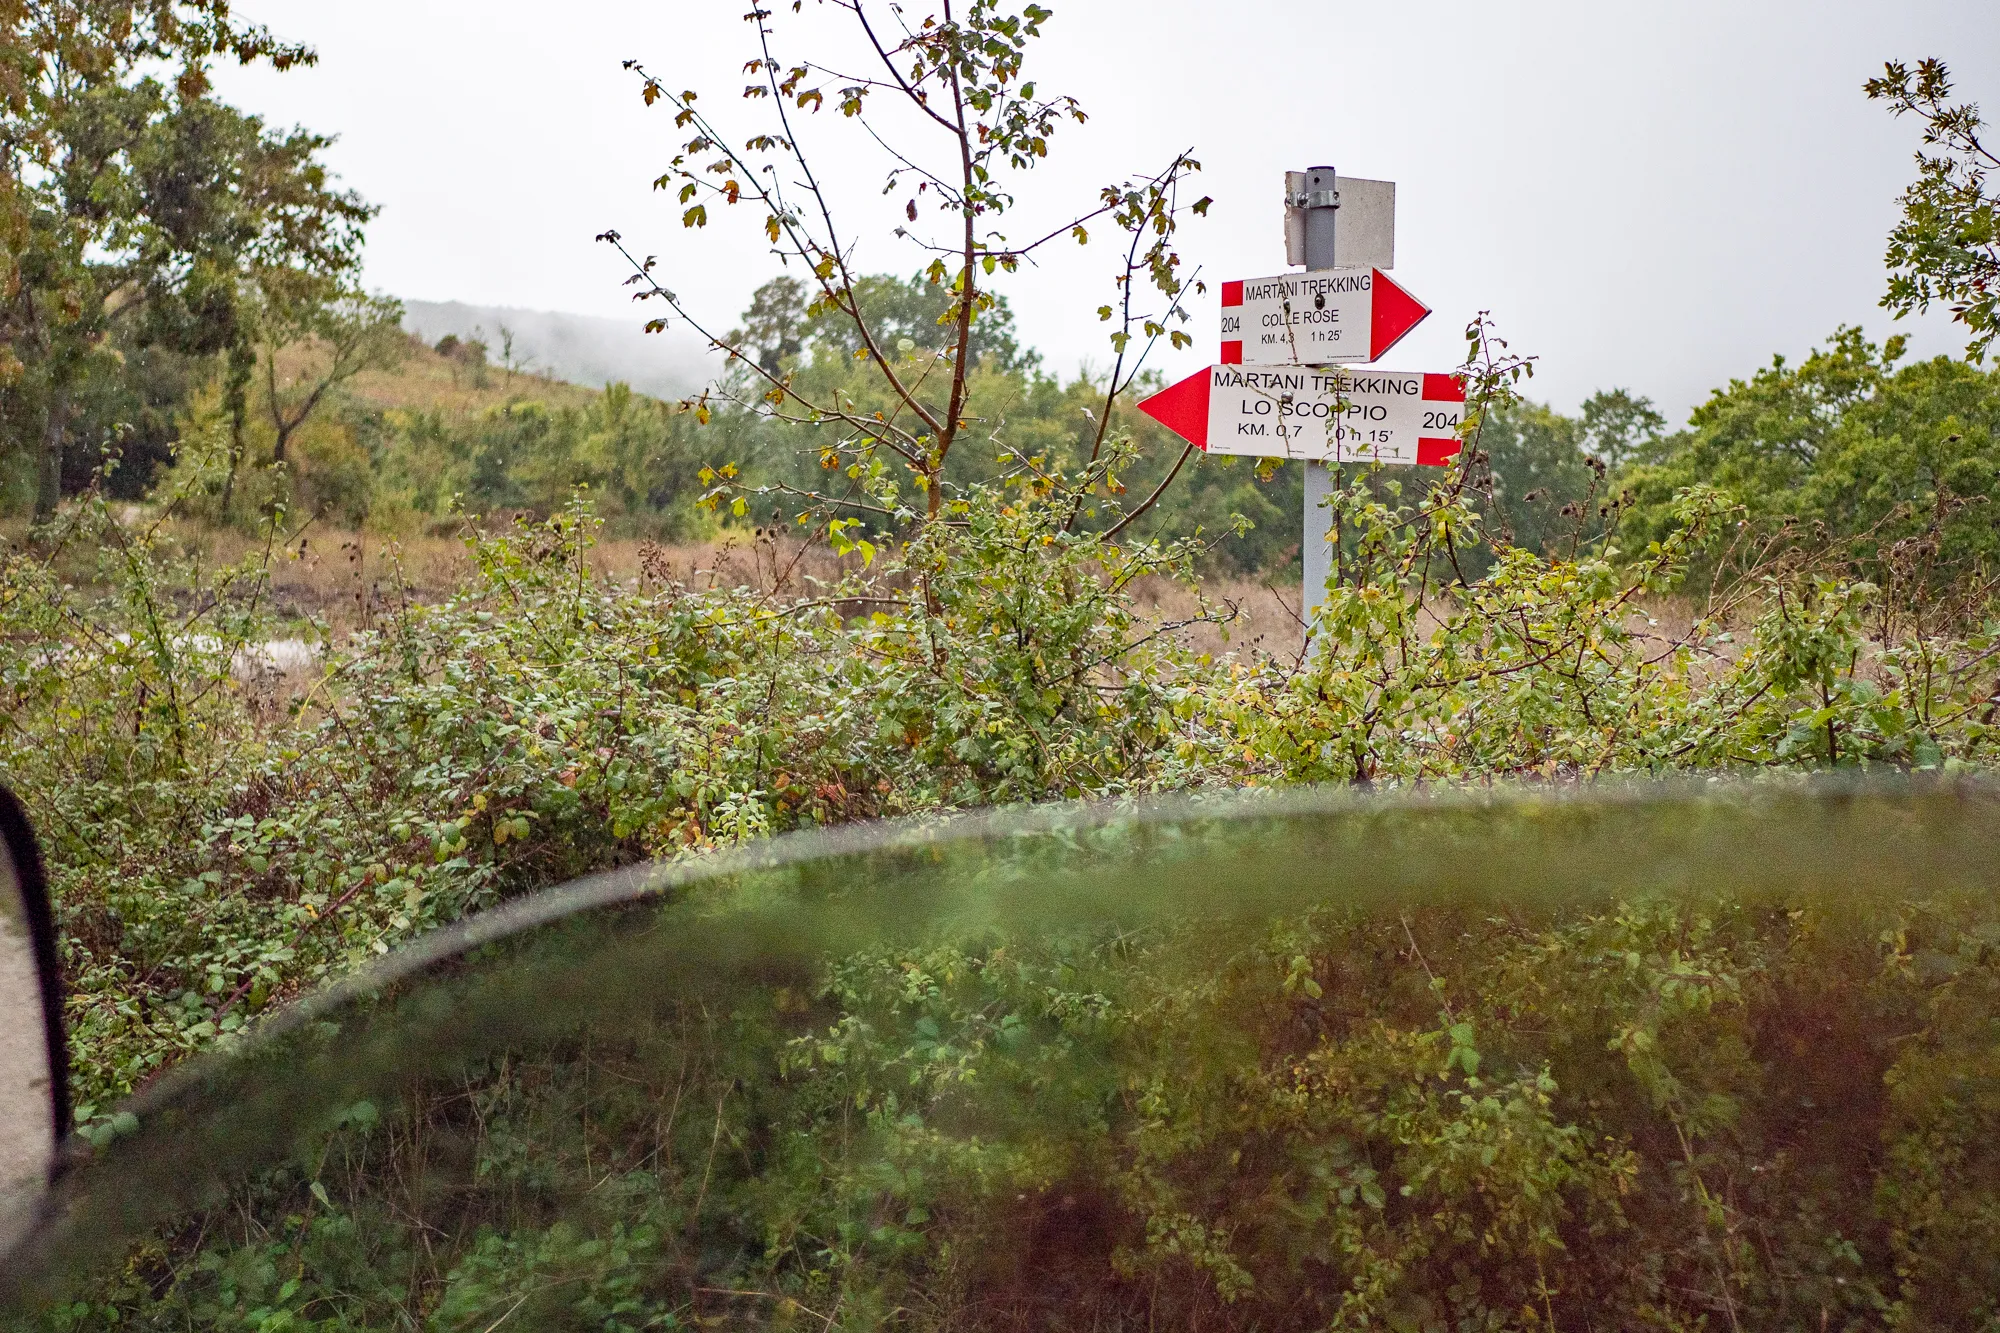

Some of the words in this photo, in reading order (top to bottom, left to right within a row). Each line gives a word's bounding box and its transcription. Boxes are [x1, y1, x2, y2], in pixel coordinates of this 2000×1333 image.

[1245, 281, 1298, 301] MARTANI
[1301, 275, 1371, 295] TREKKING
[1221, 316, 1241, 333] 204
[1303, 309, 1340, 324] ROSE
[1261, 333, 1278, 345] KM.
[1311, 331, 1316, 342] 1
[1319, 331, 1325, 342] h
[1214, 372, 1304, 390] MARTANI
[1311, 375, 1419, 396] TREKKING
[1242, 399, 1271, 415] LO
[1422, 411, 1458, 430] 204
[1237, 423, 1270, 436] KM.
[1275, 424, 1303, 439] 0,7
